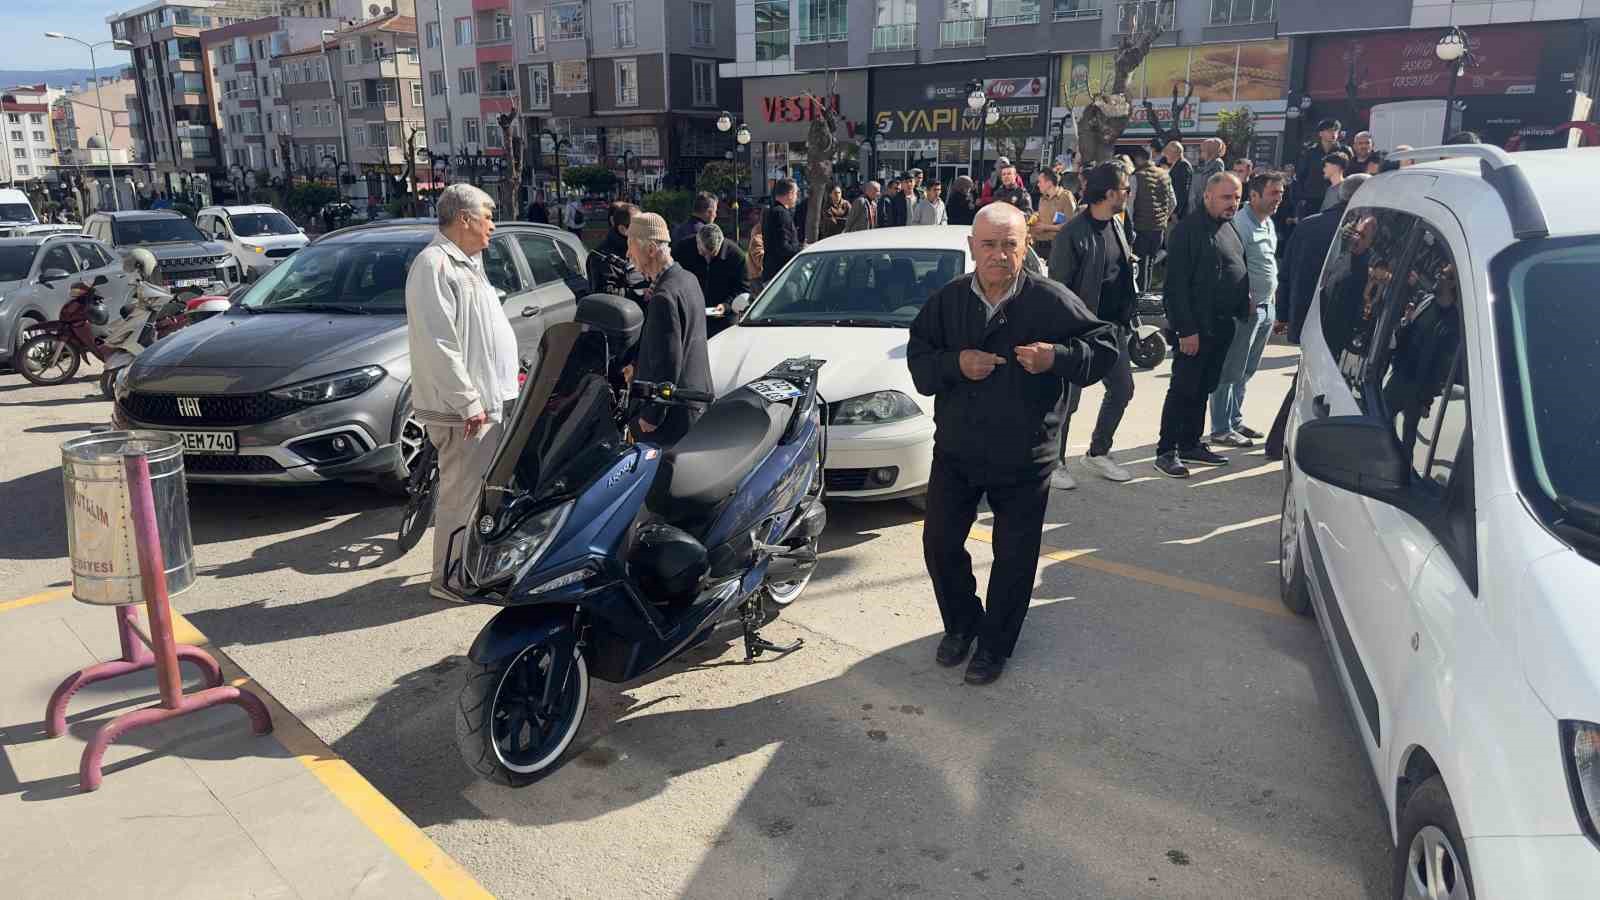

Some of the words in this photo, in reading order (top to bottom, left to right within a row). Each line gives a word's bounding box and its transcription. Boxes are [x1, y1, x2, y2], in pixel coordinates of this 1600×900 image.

[897, 108, 958, 132] YAPI
[961, 114, 1039, 130] MAKT
[176, 397, 202, 417] FIAT
[206, 433, 234, 449] 740
